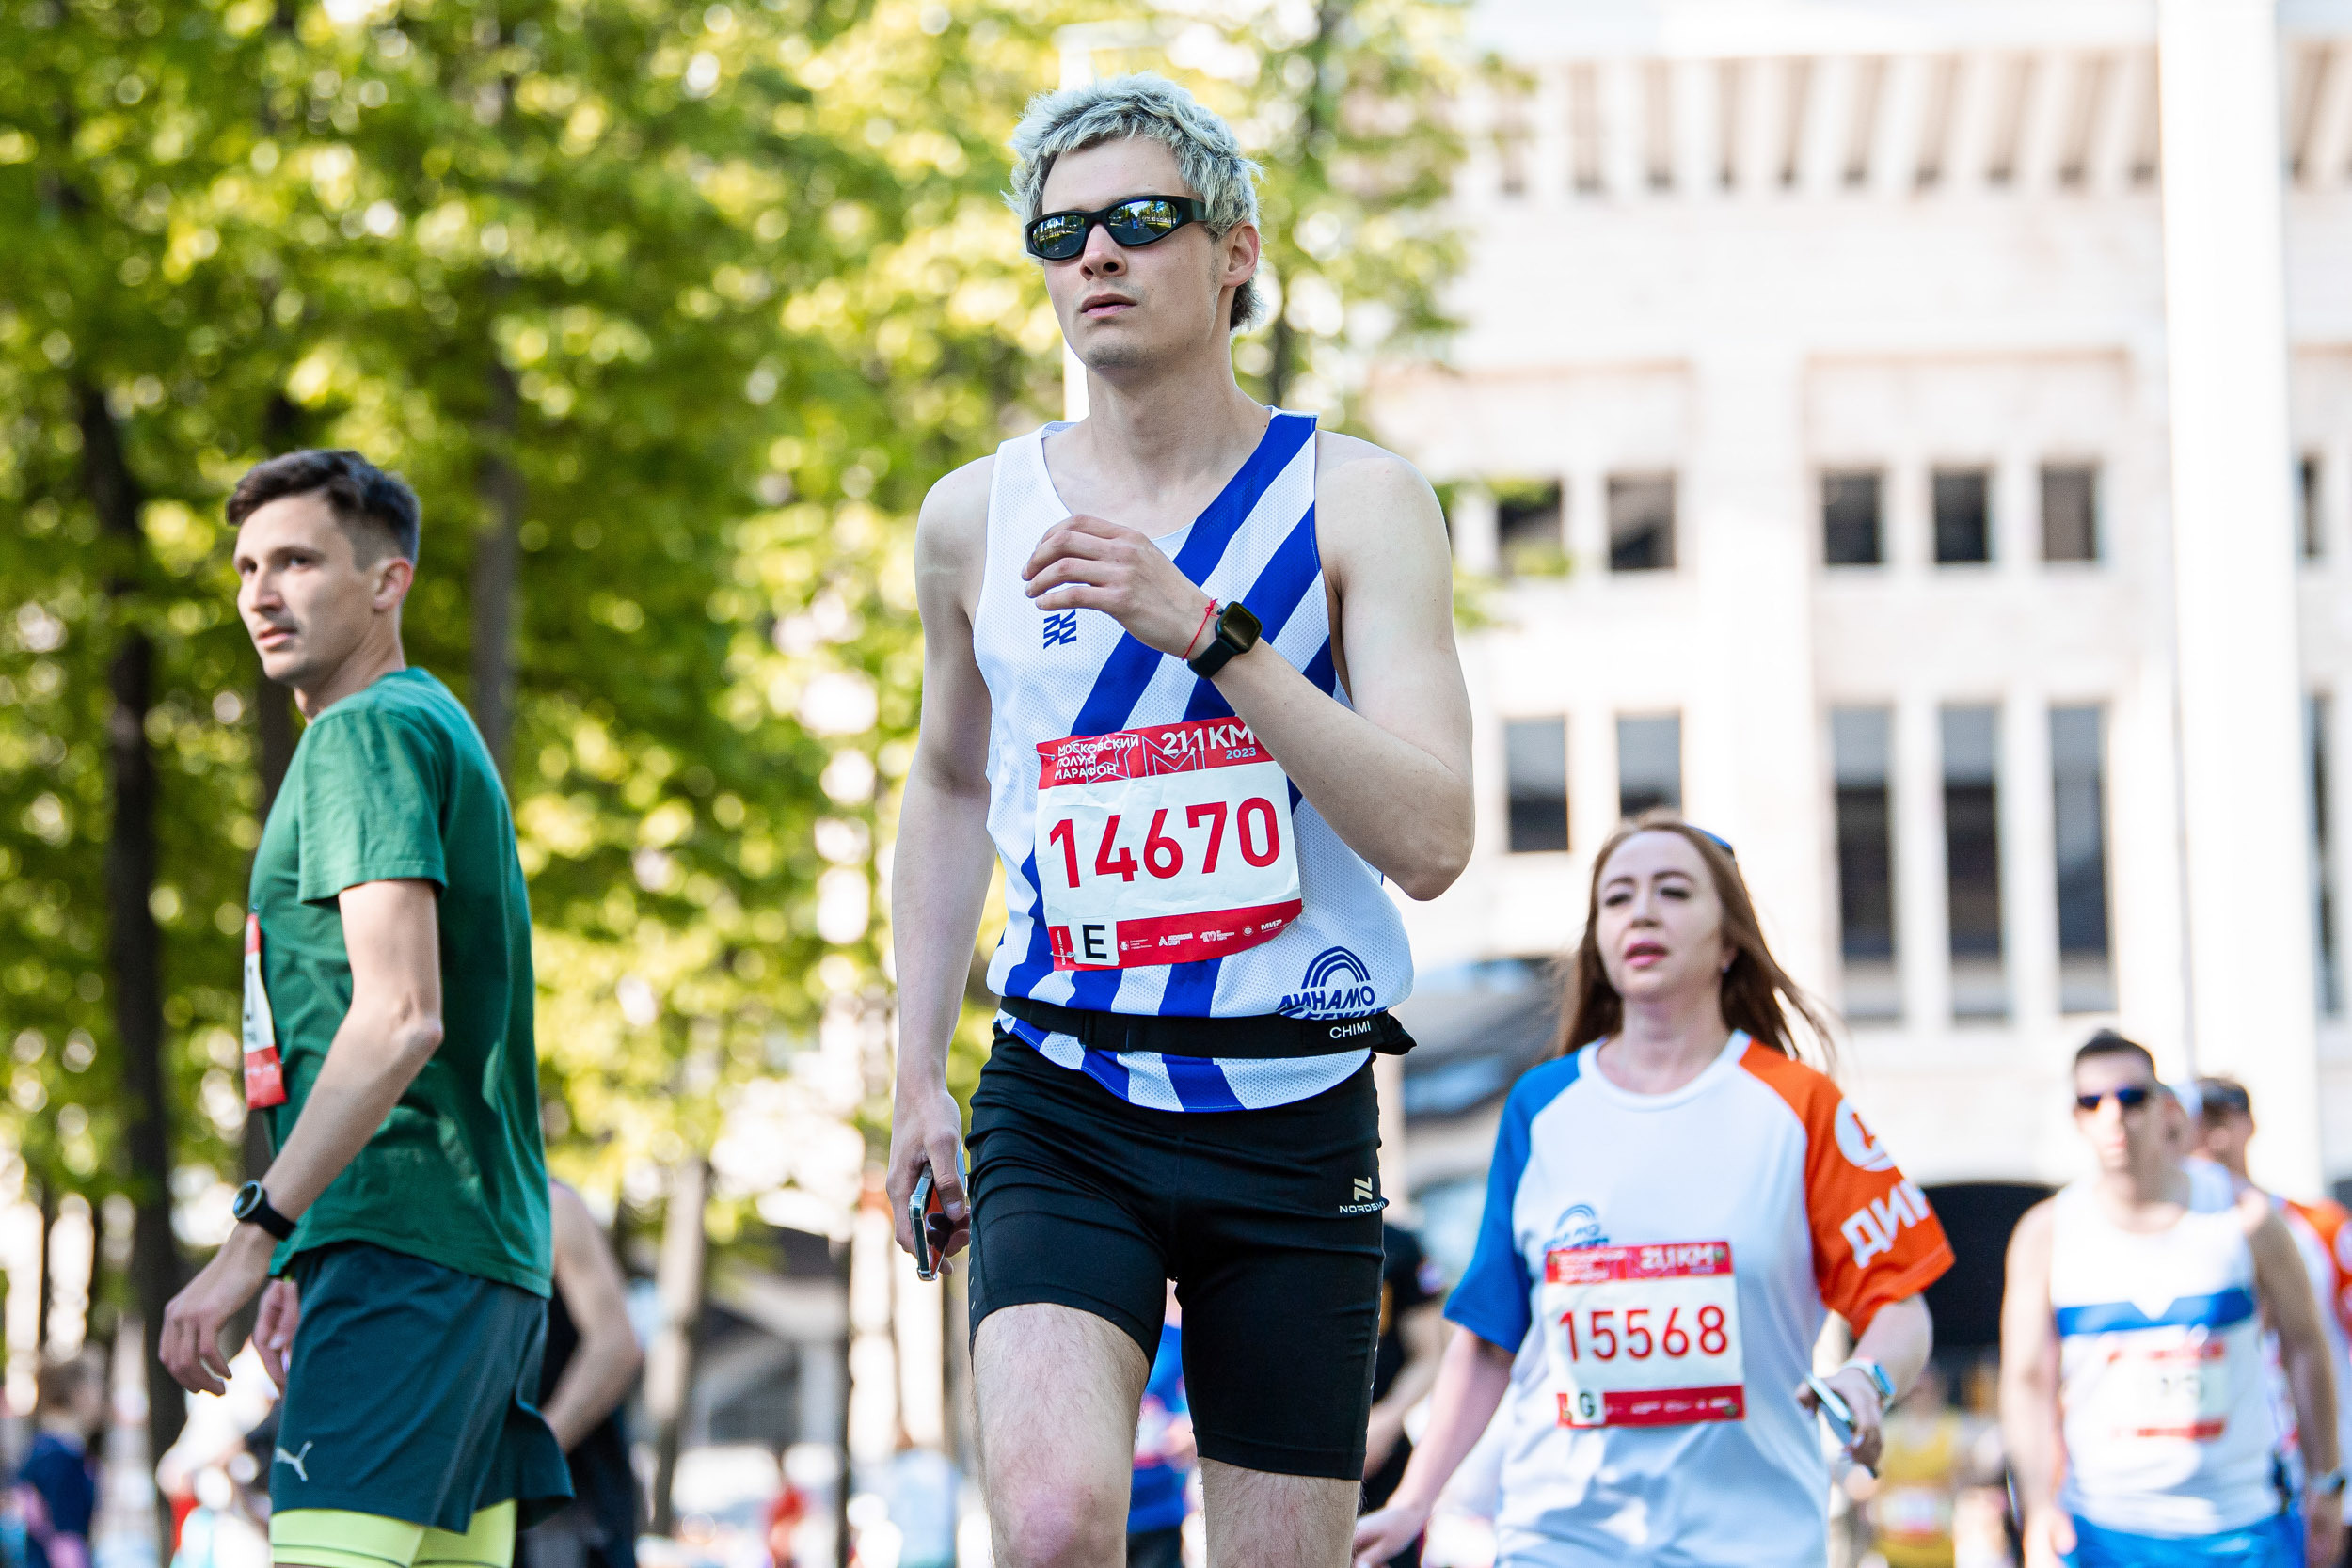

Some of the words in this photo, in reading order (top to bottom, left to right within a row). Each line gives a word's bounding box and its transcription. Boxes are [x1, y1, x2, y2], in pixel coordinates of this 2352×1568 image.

[1057, 735, 1139, 757] МОСКОВСКИЙ
[1225, 747, 1257, 760] 2023
[1057, 756, 1086, 768] ПОЛУ
[1054, 765, 1117, 780] МАРАФОН
[1049, 797, 1280, 889] 14670
[1260, 919, 1283, 930] МИР
[1082, 924, 1108, 959] E
[1329, 1020, 1372, 1039] CHIMI
[1339, 1200, 1386, 1213] NORDSKI
[1559, 1305, 1728, 1362] 15568
[1579, 1392, 1596, 1418] G
